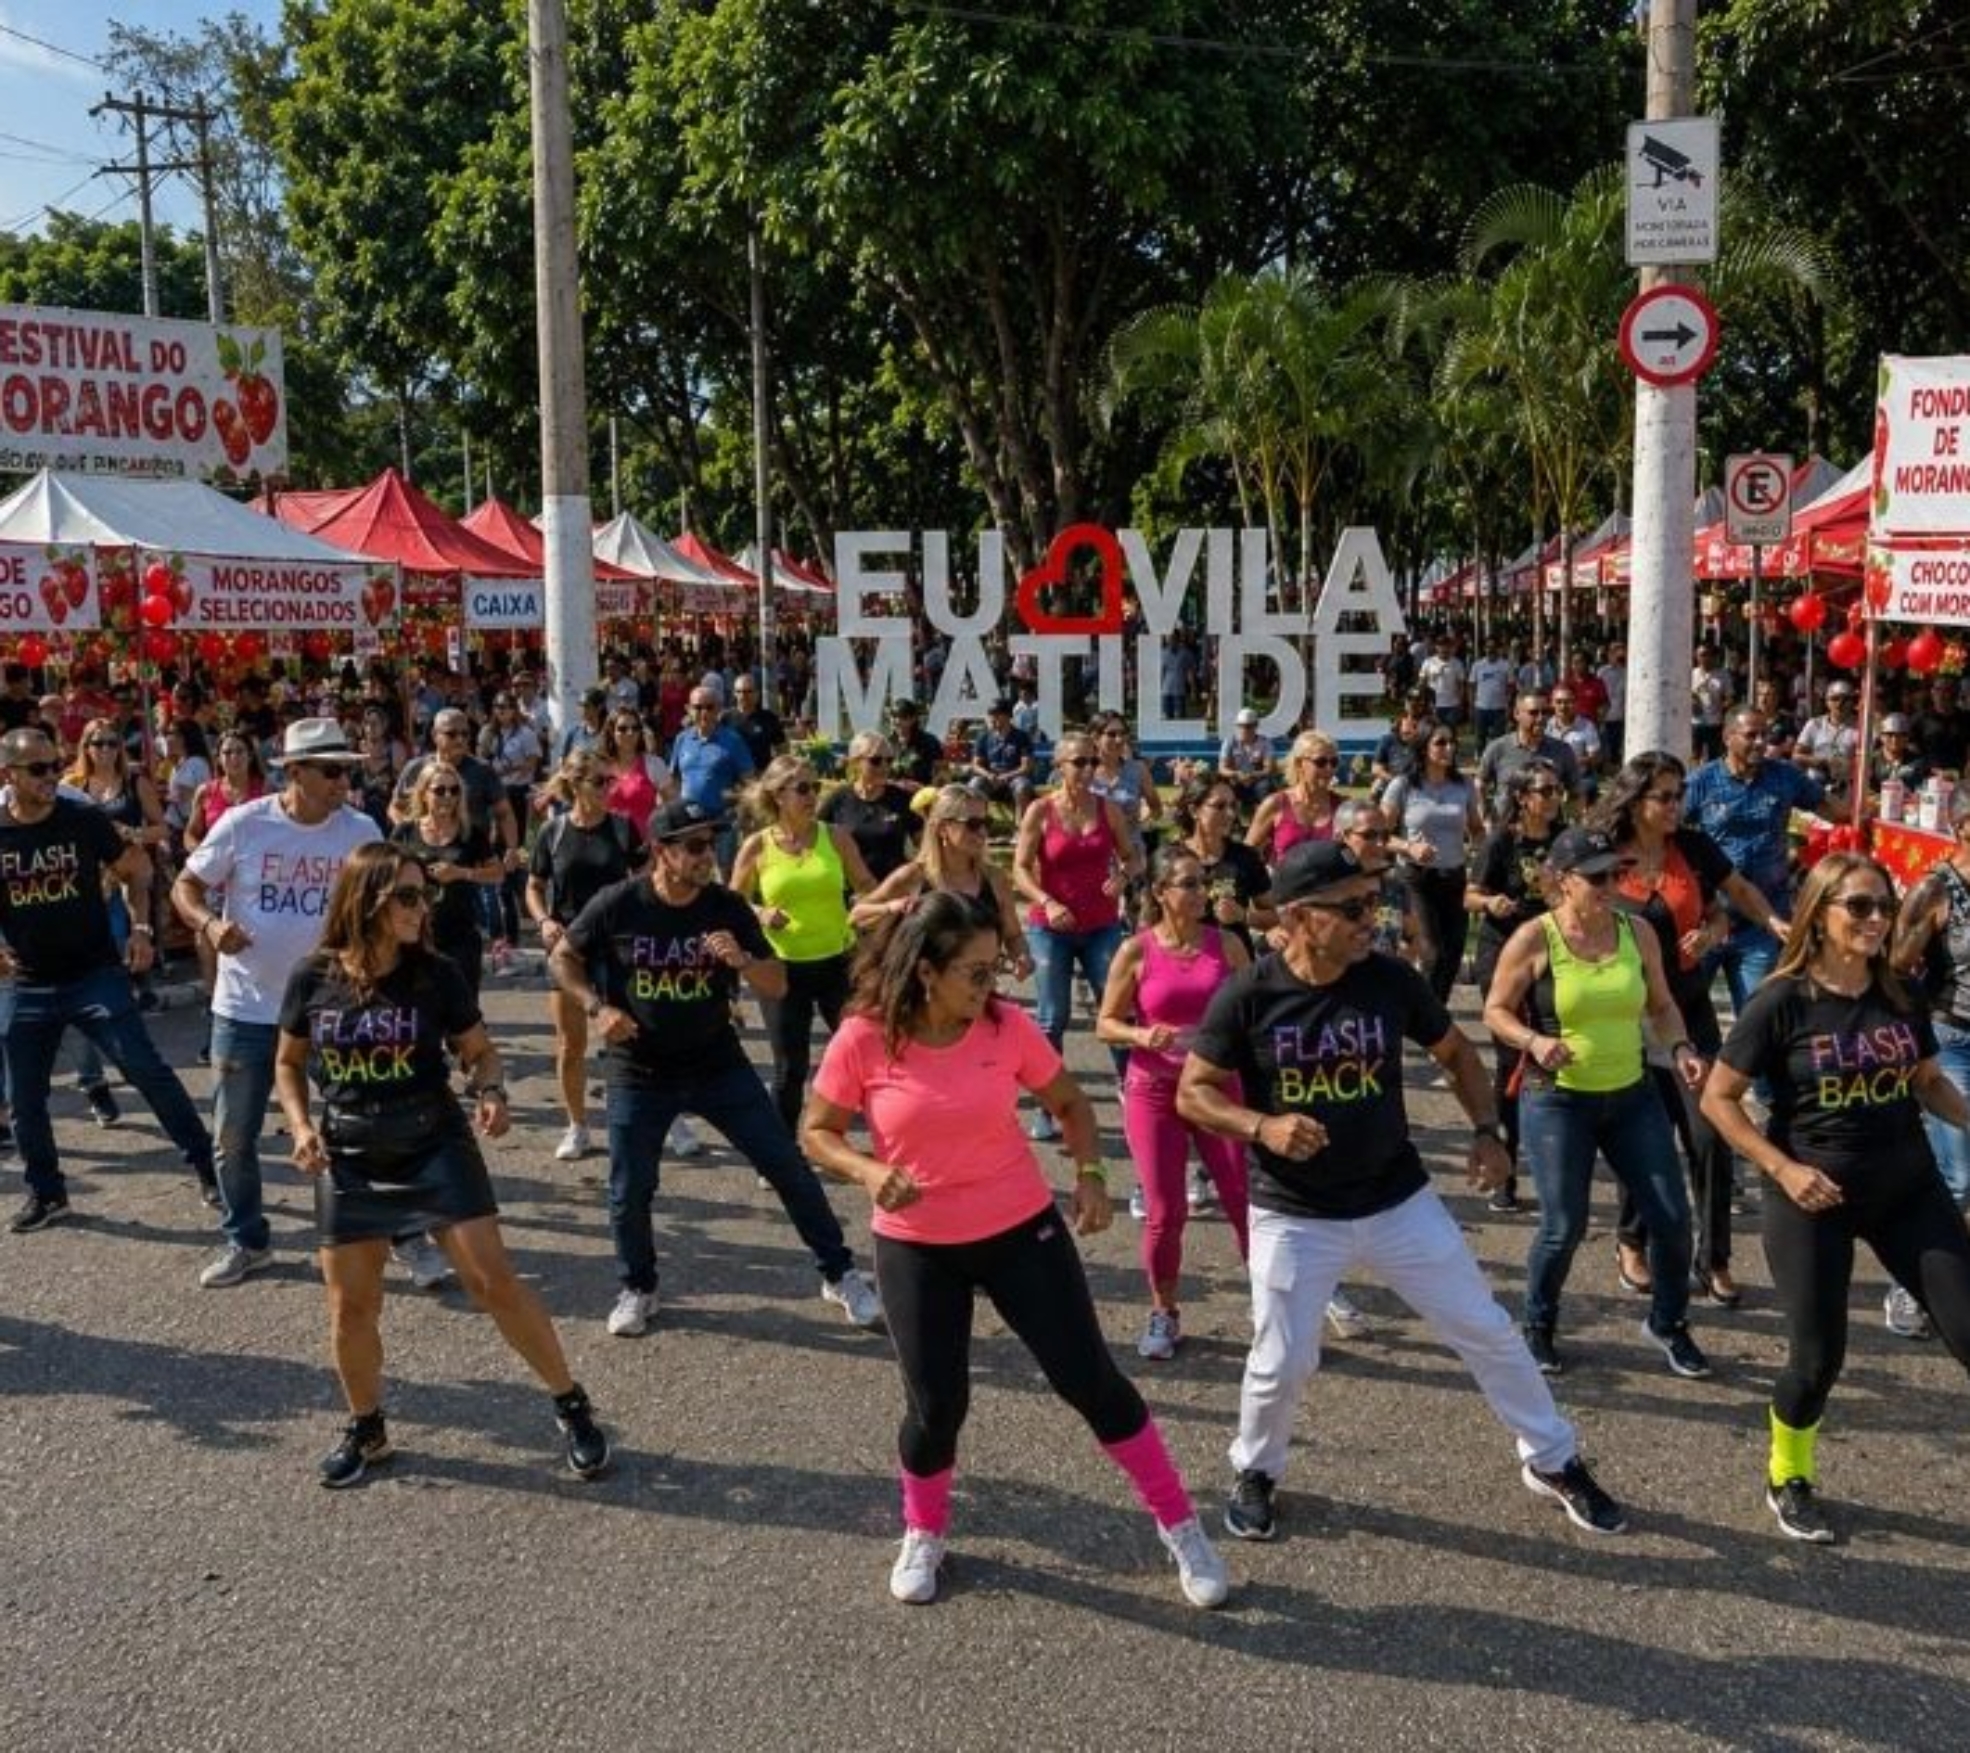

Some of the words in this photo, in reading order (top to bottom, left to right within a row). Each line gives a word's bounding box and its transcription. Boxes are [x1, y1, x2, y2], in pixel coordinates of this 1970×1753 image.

[1658, 196, 1687, 212] VIA
[150, 340, 187, 374] DO
[0, 372, 207, 443] ORANGO
[1933, 426, 1960, 456] DE
[212, 566, 342, 594] MORANGOS
[834, 530, 1000, 637] EU
[1117, 526, 1405, 635] VILA
[200, 598, 357, 622] SELECIONADOS
[473, 593, 537, 617] CAIXA
[816, 634, 1395, 740] MATILDE
[2, 842, 77, 877] FLASH
[9, 872, 79, 906] BACK
[636, 970, 714, 1000] BACK
[311, 1006, 418, 1044] FLASH
[1274, 1017, 1384, 1064] FLASH
[321, 1045, 415, 1081] BACK
[1811, 1023, 1918, 1070] FLASH
[1281, 1057, 1384, 1103] BACK
[1819, 1065, 1919, 1108] BACK
